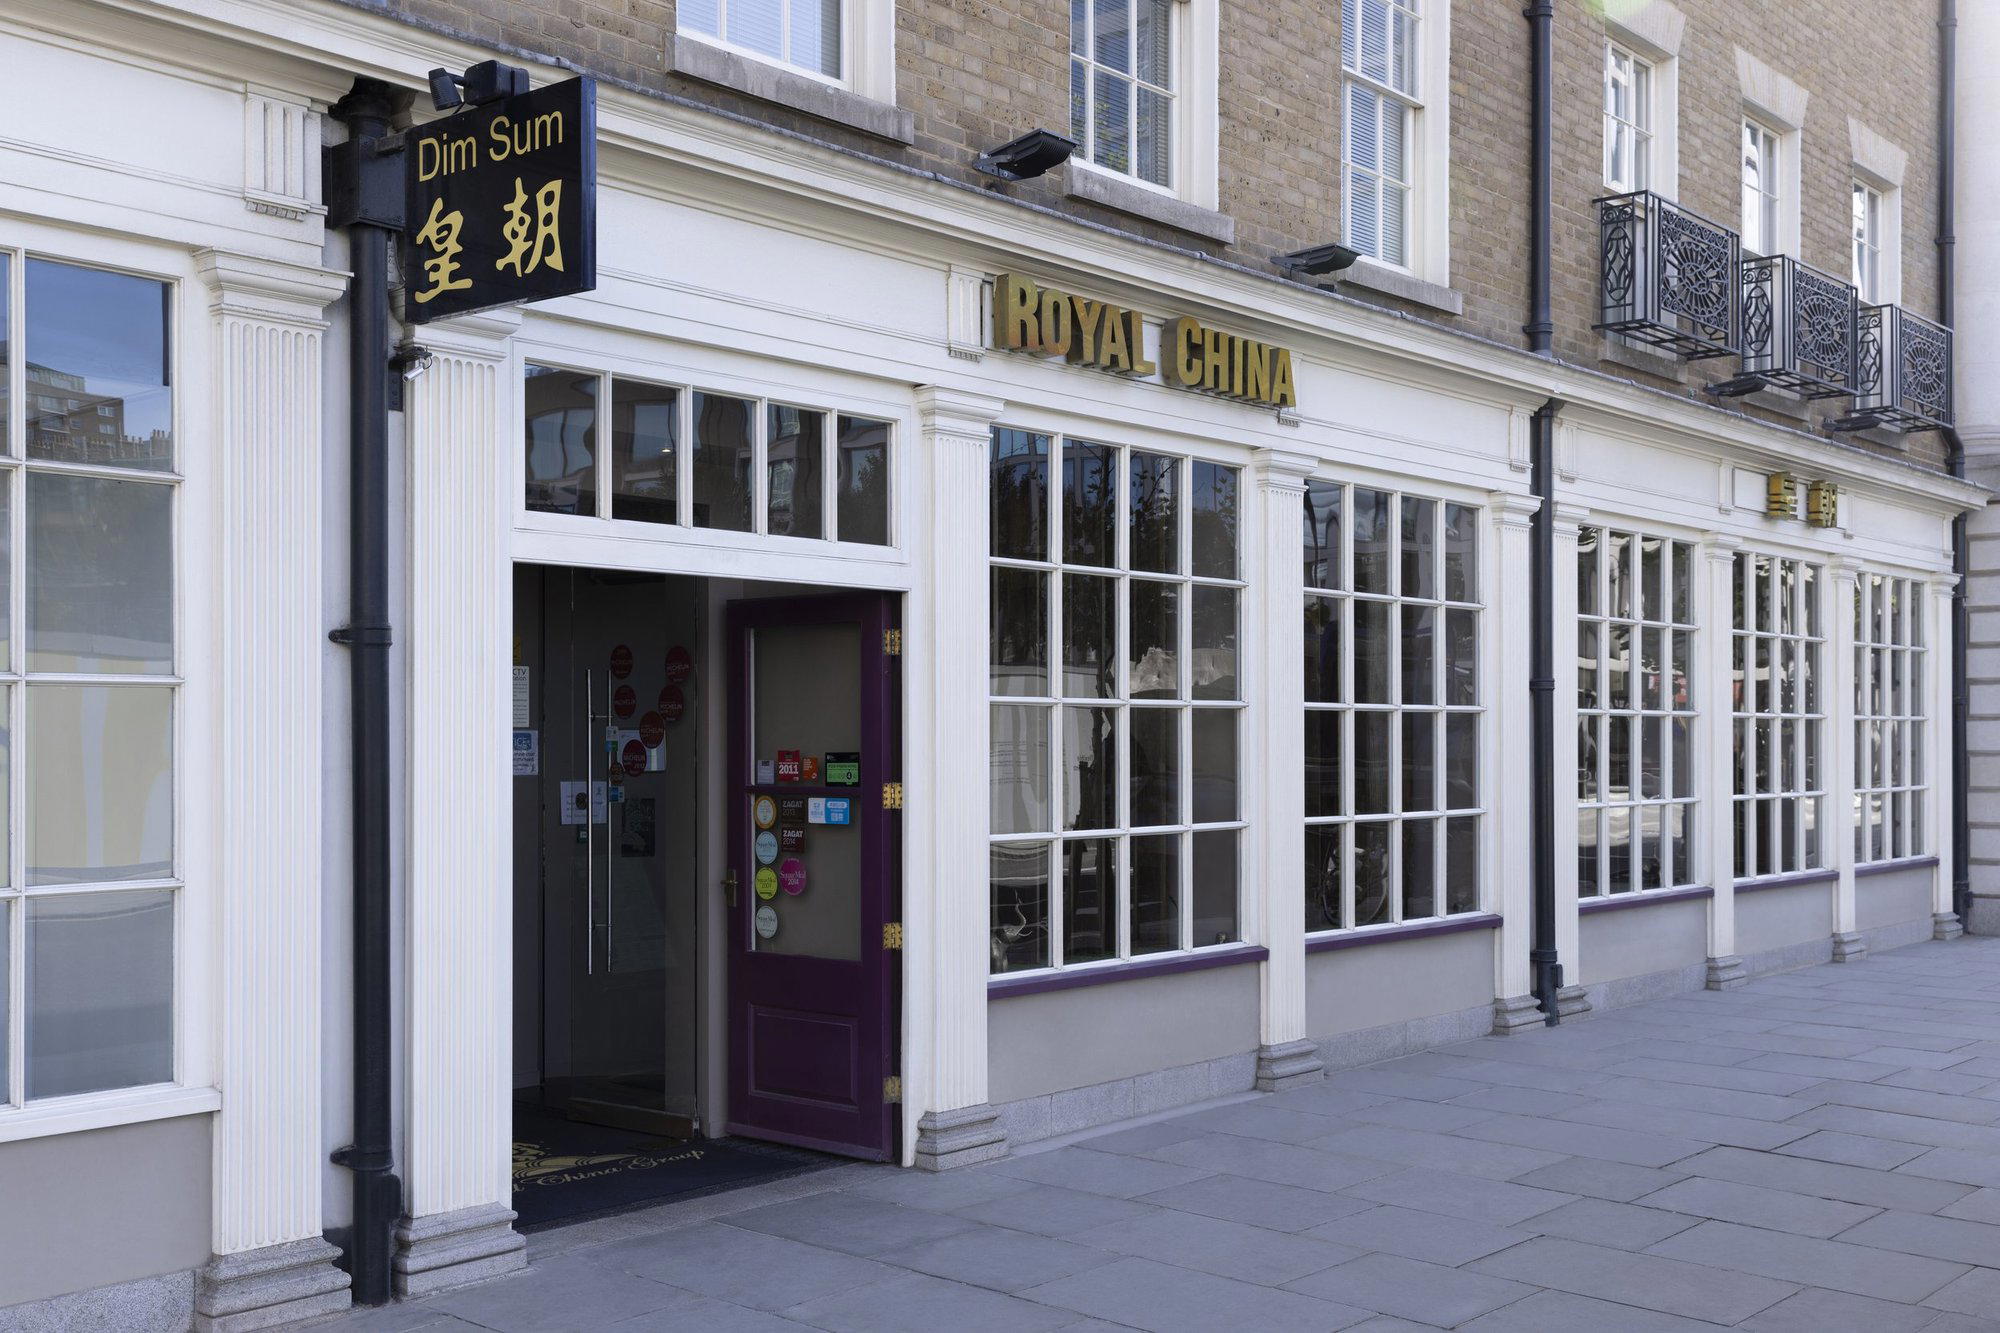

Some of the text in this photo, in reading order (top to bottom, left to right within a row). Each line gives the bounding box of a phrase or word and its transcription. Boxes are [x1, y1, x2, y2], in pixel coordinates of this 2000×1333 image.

[418, 110, 563, 182] Dim Sum
[994, 272, 1297, 408] ROYAL CHINA
[778, 764, 799, 775] 2011
[782, 800, 803, 808] ZAGAT
[782, 830, 803, 838] ZAGAT
[618, 1149, 705, 1171] Group
